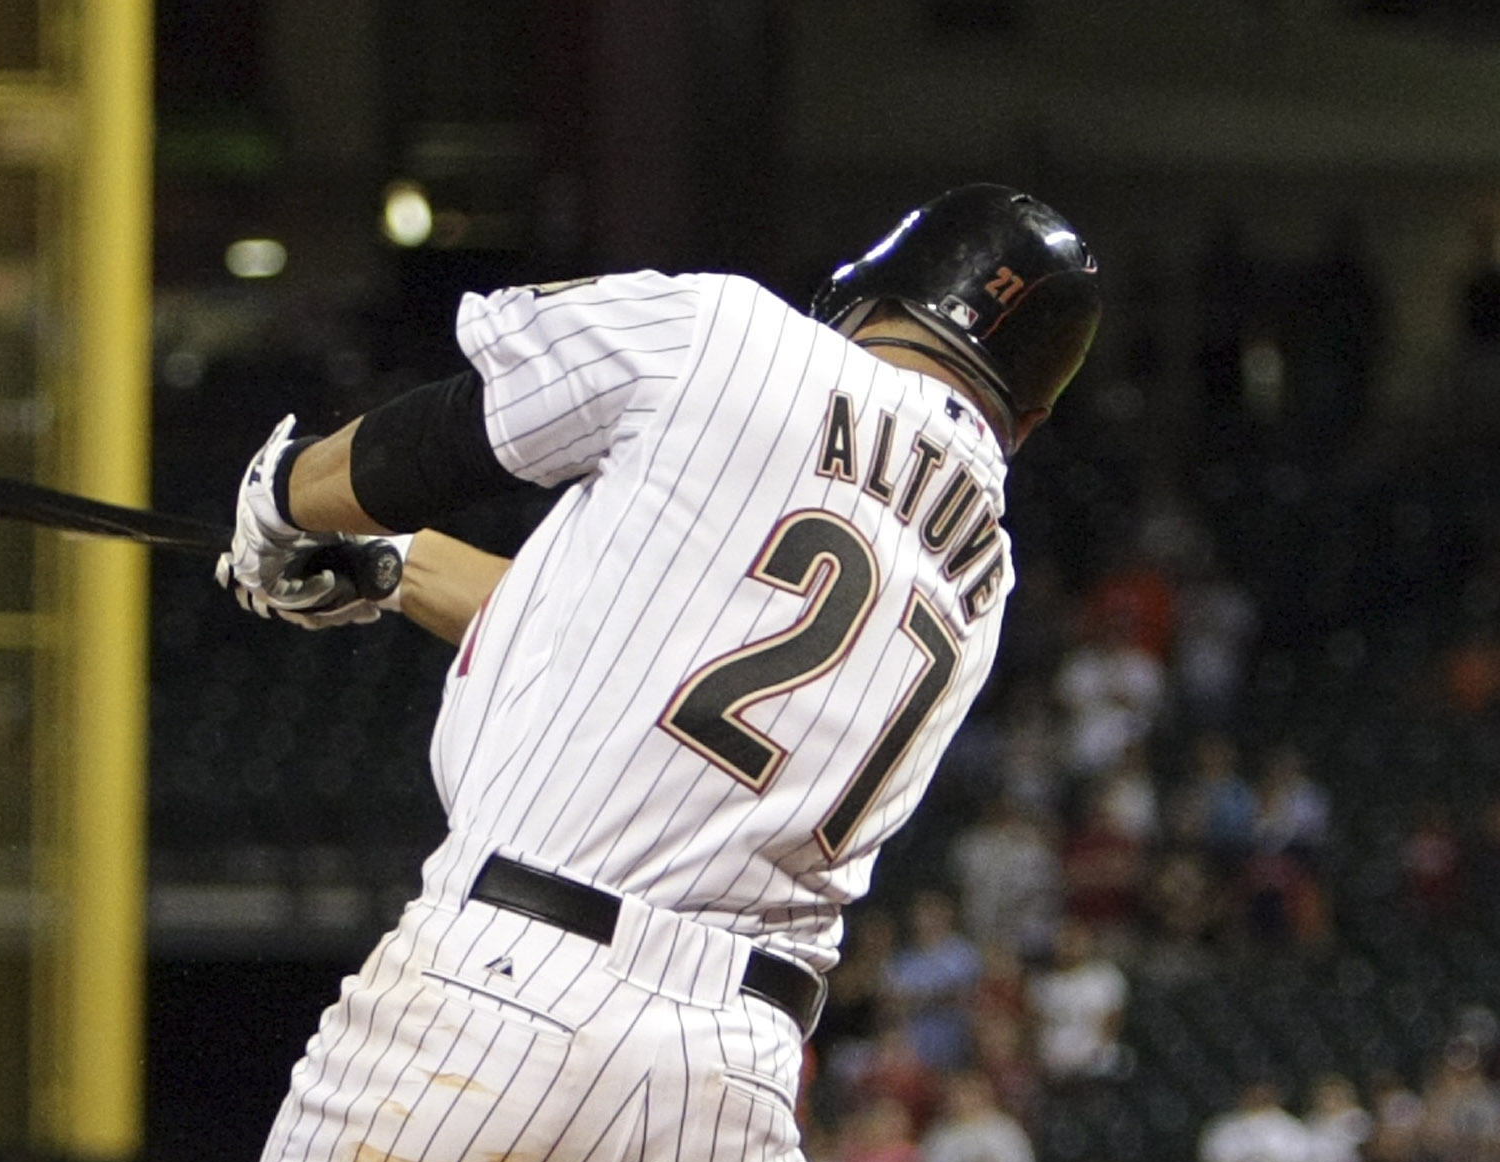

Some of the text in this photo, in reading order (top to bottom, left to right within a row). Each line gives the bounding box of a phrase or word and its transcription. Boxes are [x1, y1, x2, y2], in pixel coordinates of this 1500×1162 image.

[985, 266, 1024, 304] 27
[815, 389, 1005, 624] ALTUVE
[657, 507, 961, 862] 27
